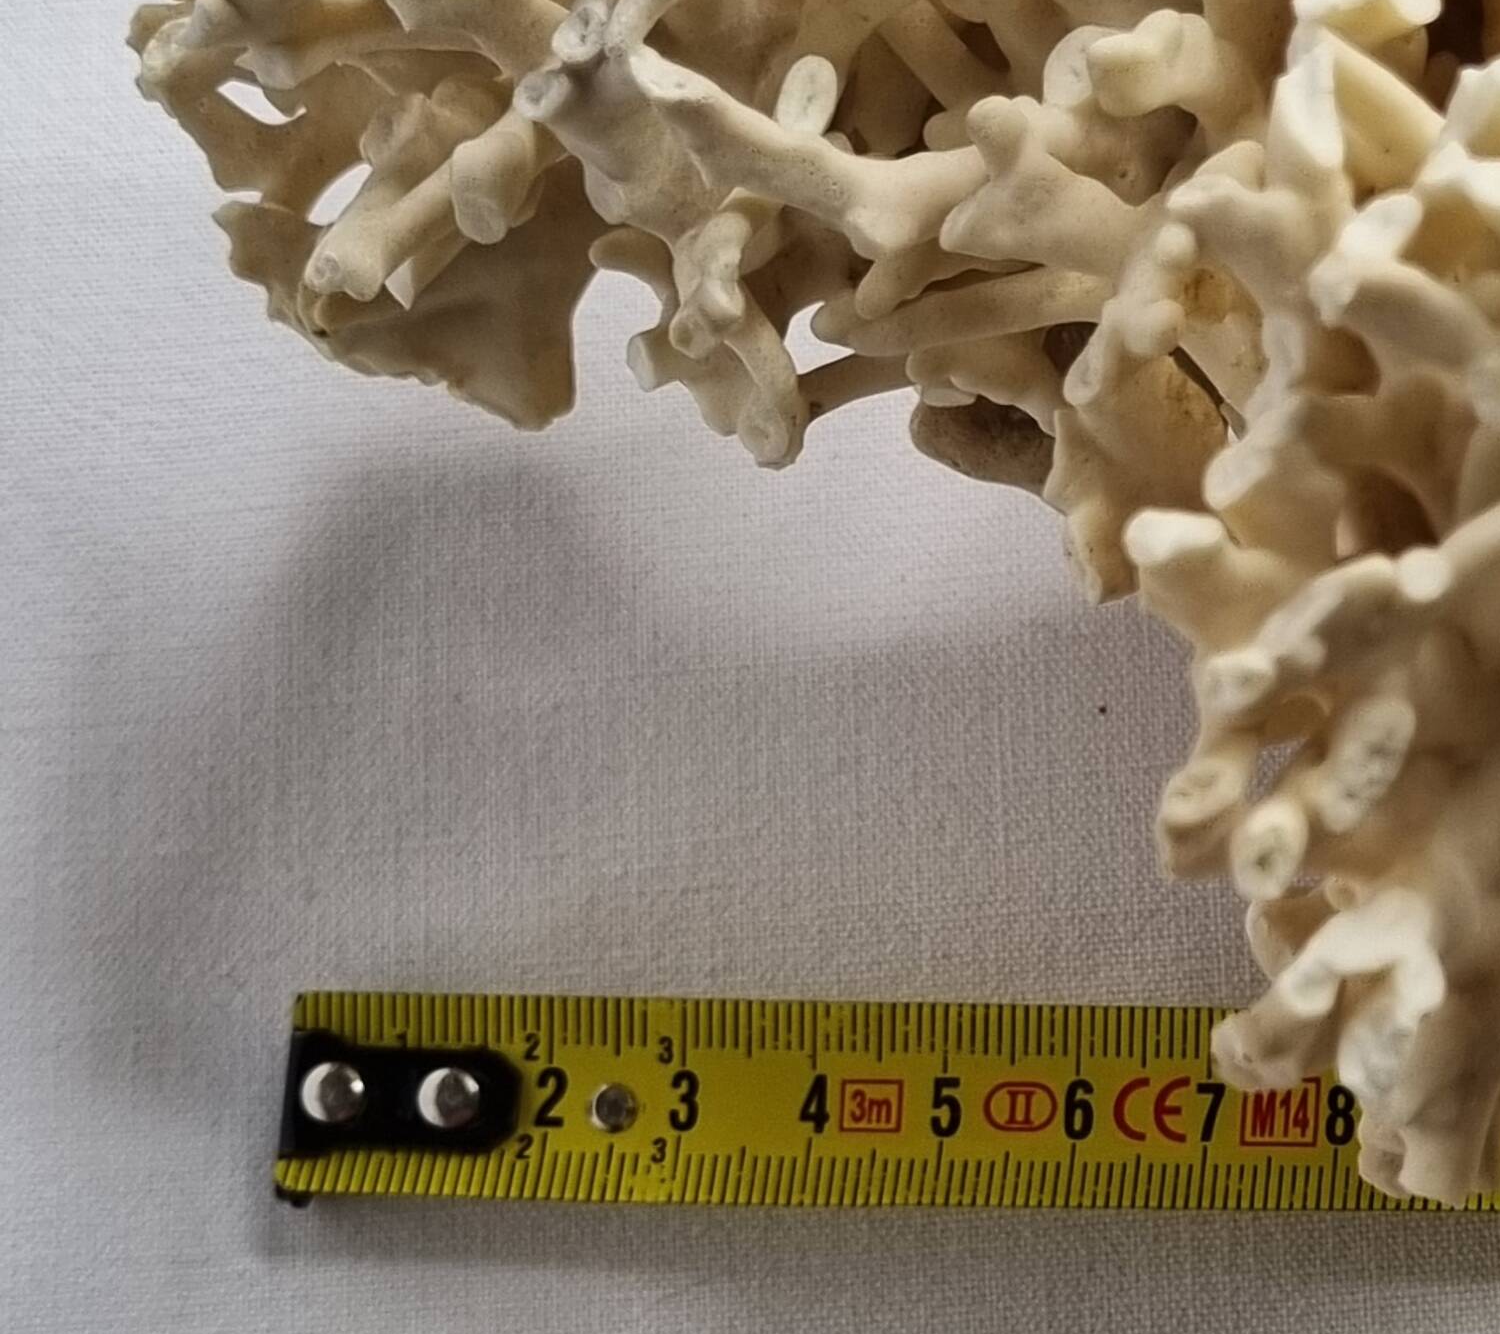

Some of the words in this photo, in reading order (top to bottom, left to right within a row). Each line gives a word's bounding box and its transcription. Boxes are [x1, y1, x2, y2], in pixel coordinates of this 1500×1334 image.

[525, 1033, 540, 1061] 2
[659, 1036, 674, 1064] 3
[534, 1067, 568, 1127] 2
[669, 1070, 699, 1131] 3
[800, 1074, 829, 1133] 4
[850, 1089, 893, 1124] 3m
[931, 1077, 961, 1137] 5
[1064, 1079, 1093, 1140] 6
[1197, 1083, 1225, 1142] 7
[1251, 1089, 1310, 1138] M14
[1325, 1085, 1355, 1146] 8
[516, 1134, 533, 1159] 2
[651, 1137, 667, 1163] 3
